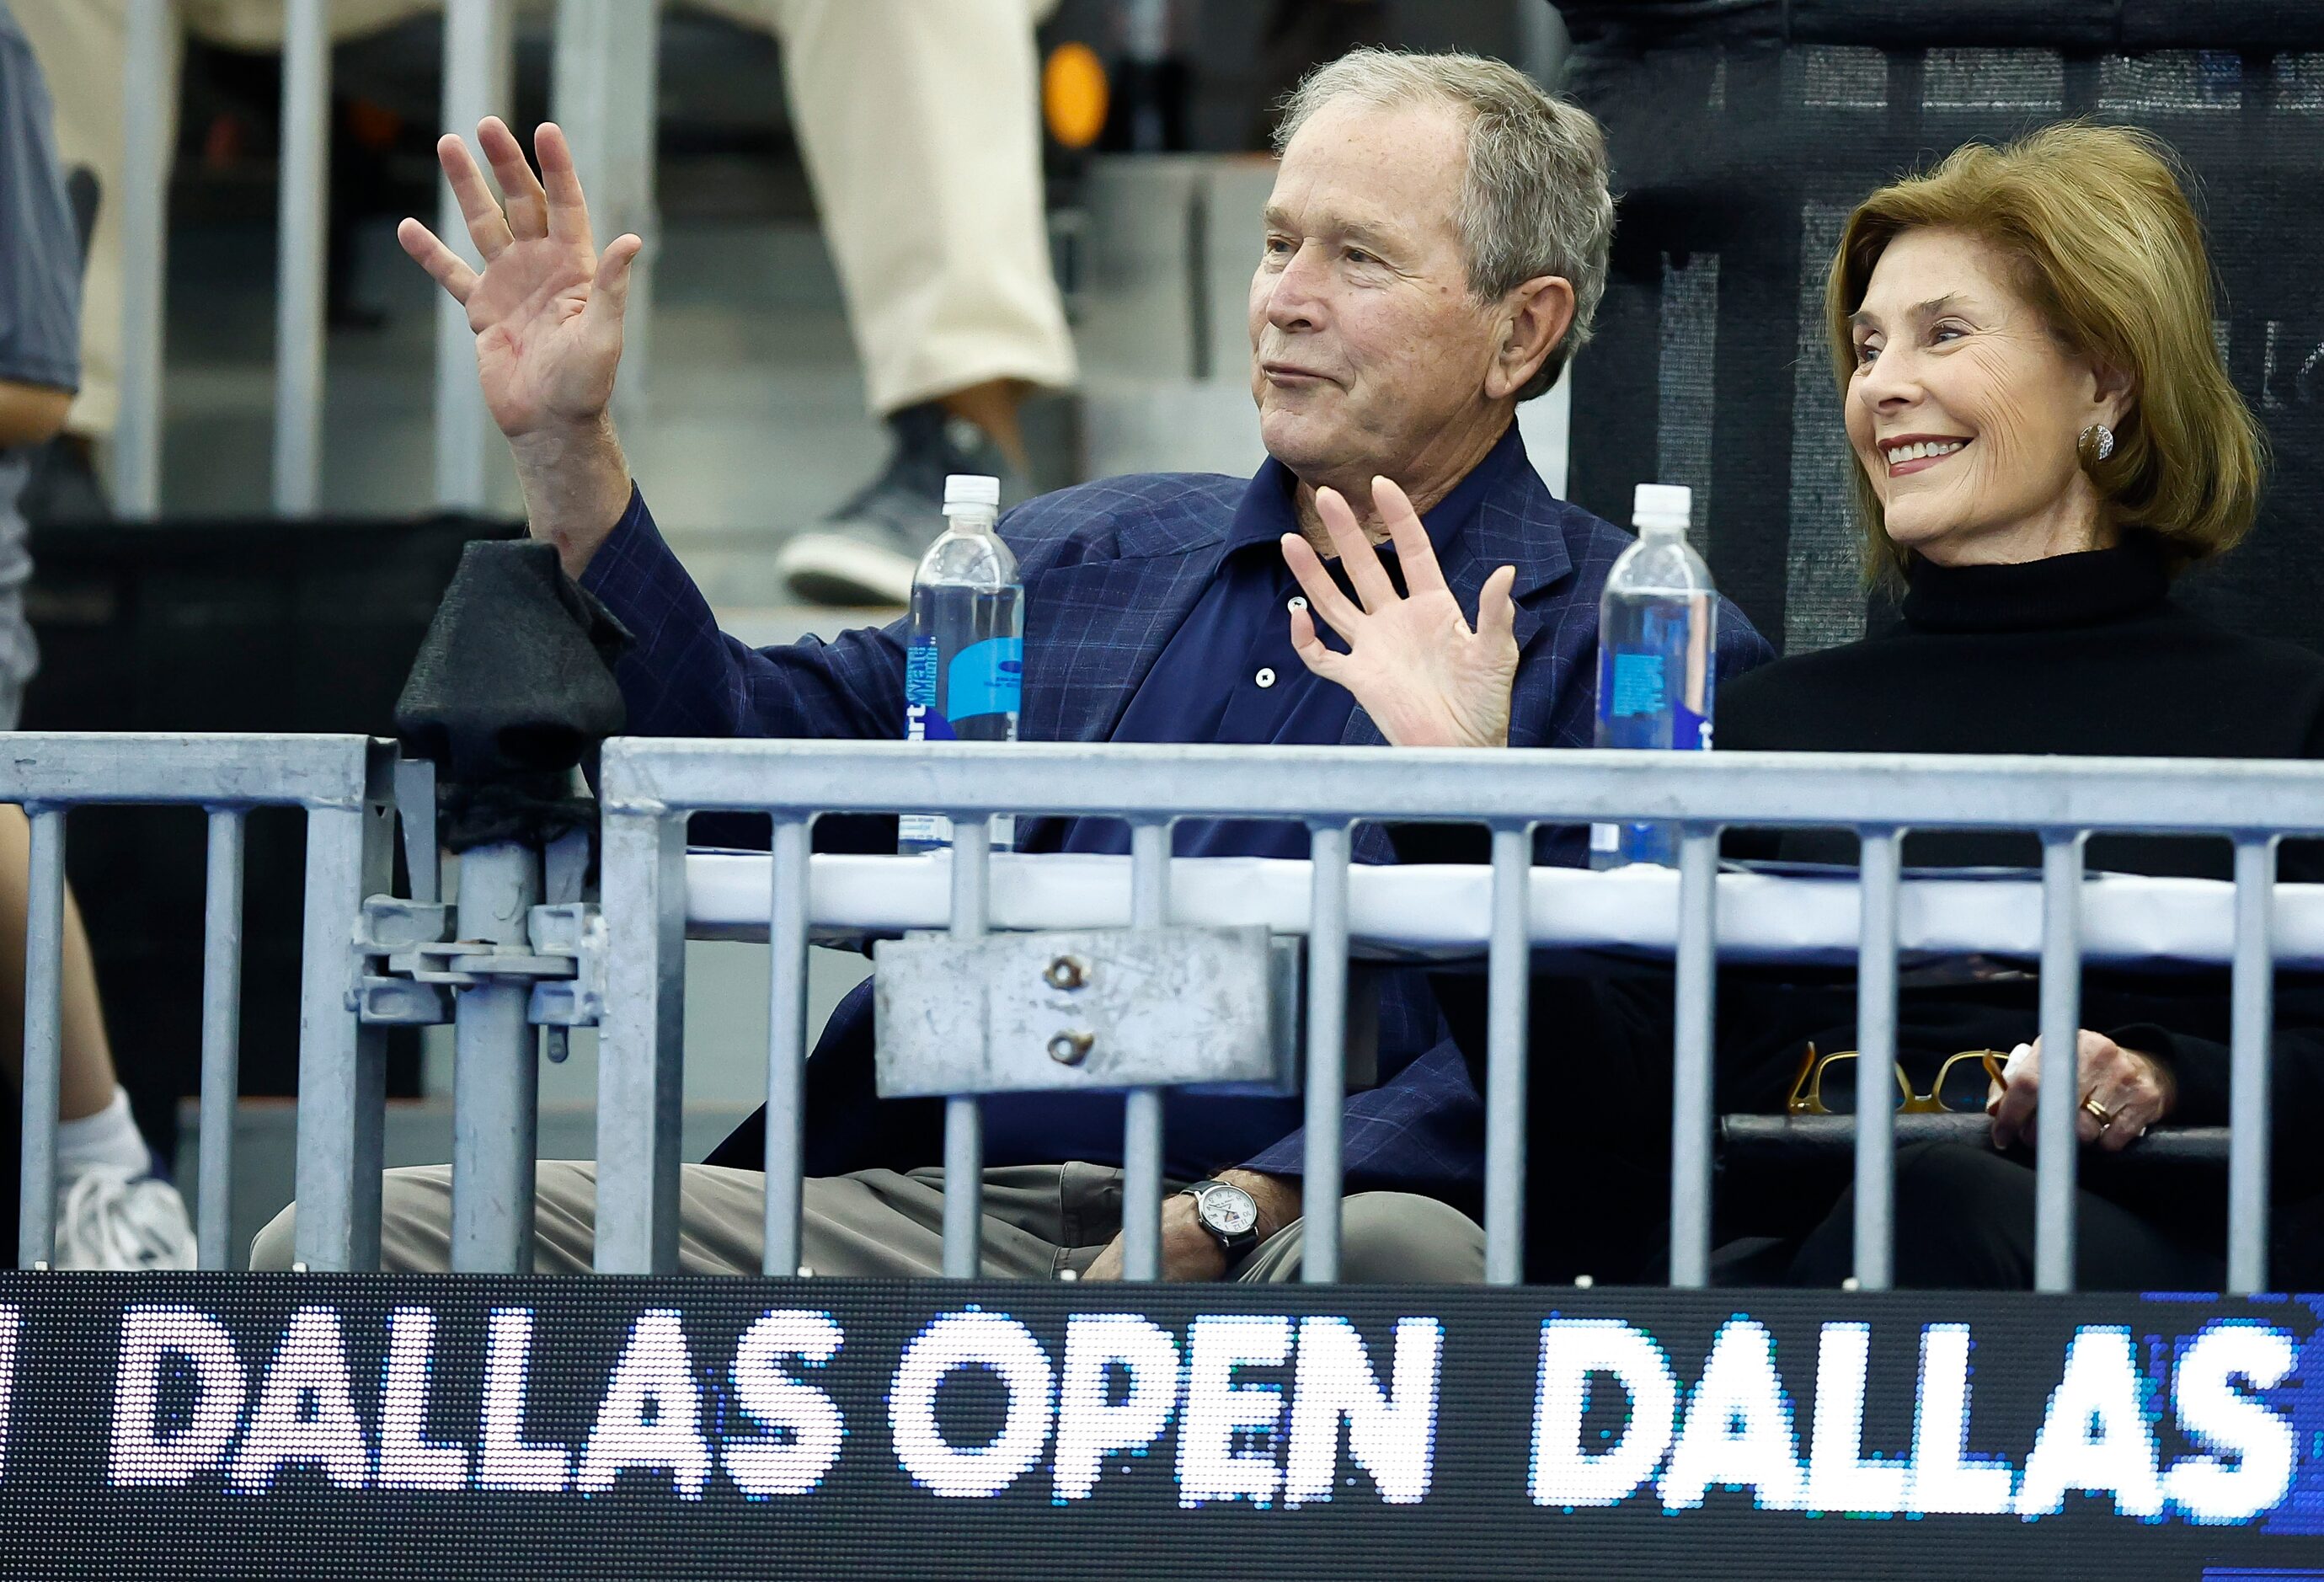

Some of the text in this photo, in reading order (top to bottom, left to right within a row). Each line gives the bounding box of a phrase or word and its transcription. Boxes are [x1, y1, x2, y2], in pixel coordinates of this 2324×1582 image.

[108, 1304, 845, 1499] DALLAS
[888, 1306, 1444, 1508] OPEN
[1529, 1312, 2298, 1524] DALLAS
